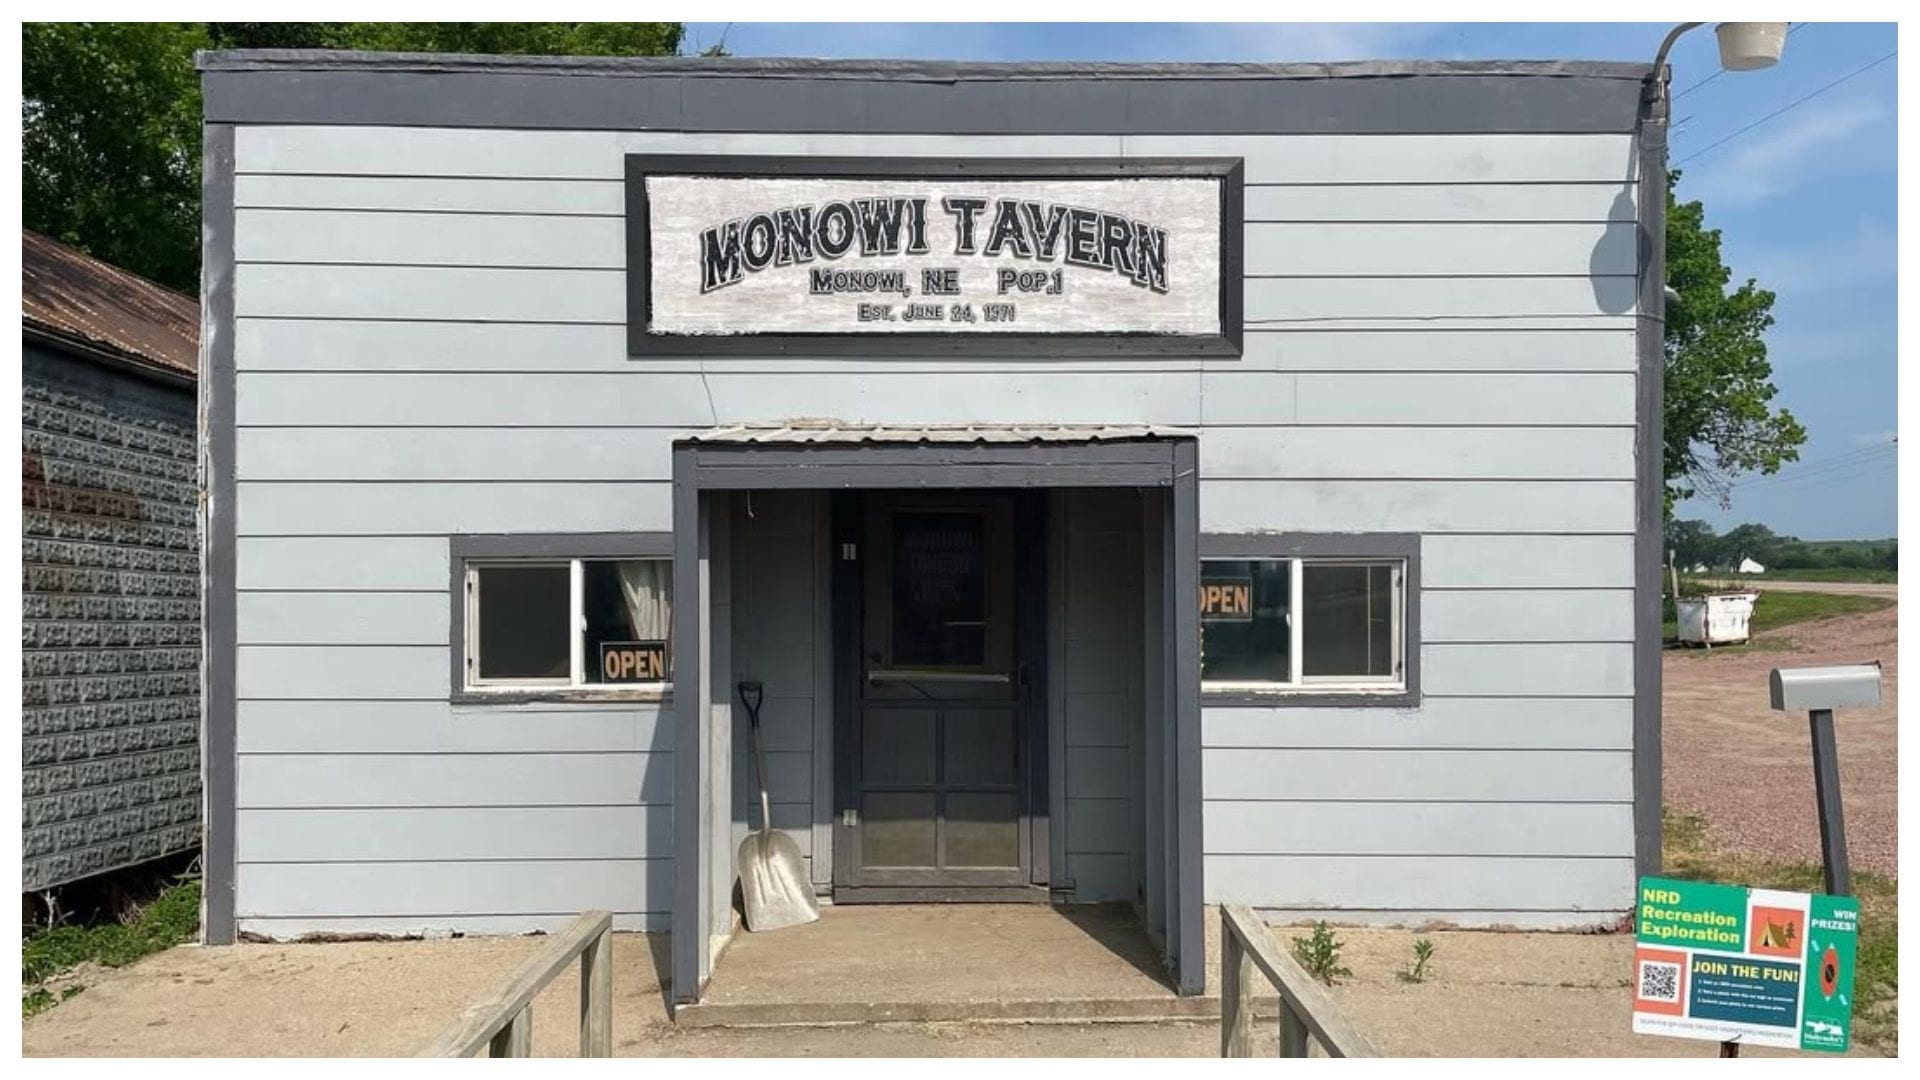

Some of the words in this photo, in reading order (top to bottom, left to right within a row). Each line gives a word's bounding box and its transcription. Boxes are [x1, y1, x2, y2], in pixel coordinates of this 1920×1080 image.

[701, 196, 928, 294] MONOWI
[944, 196, 1171, 294] TAVERN
[809, 268, 911, 297] MONOWI,
[983, 304, 1017, 322] 1971
[605, 650, 664, 679] OPEN
[1643, 888, 1681, 905] NRD
[1642, 904, 1738, 928] Recreation
[1811, 918, 1856, 932] PRIZES!
[1833, 909, 1857, 920] WIN
[1641, 920, 1741, 945] Exploration
[1692, 961, 1728, 976] JOIN
[1731, 964, 1761, 979] THE
[1763, 967, 1799, 983] FUN!
